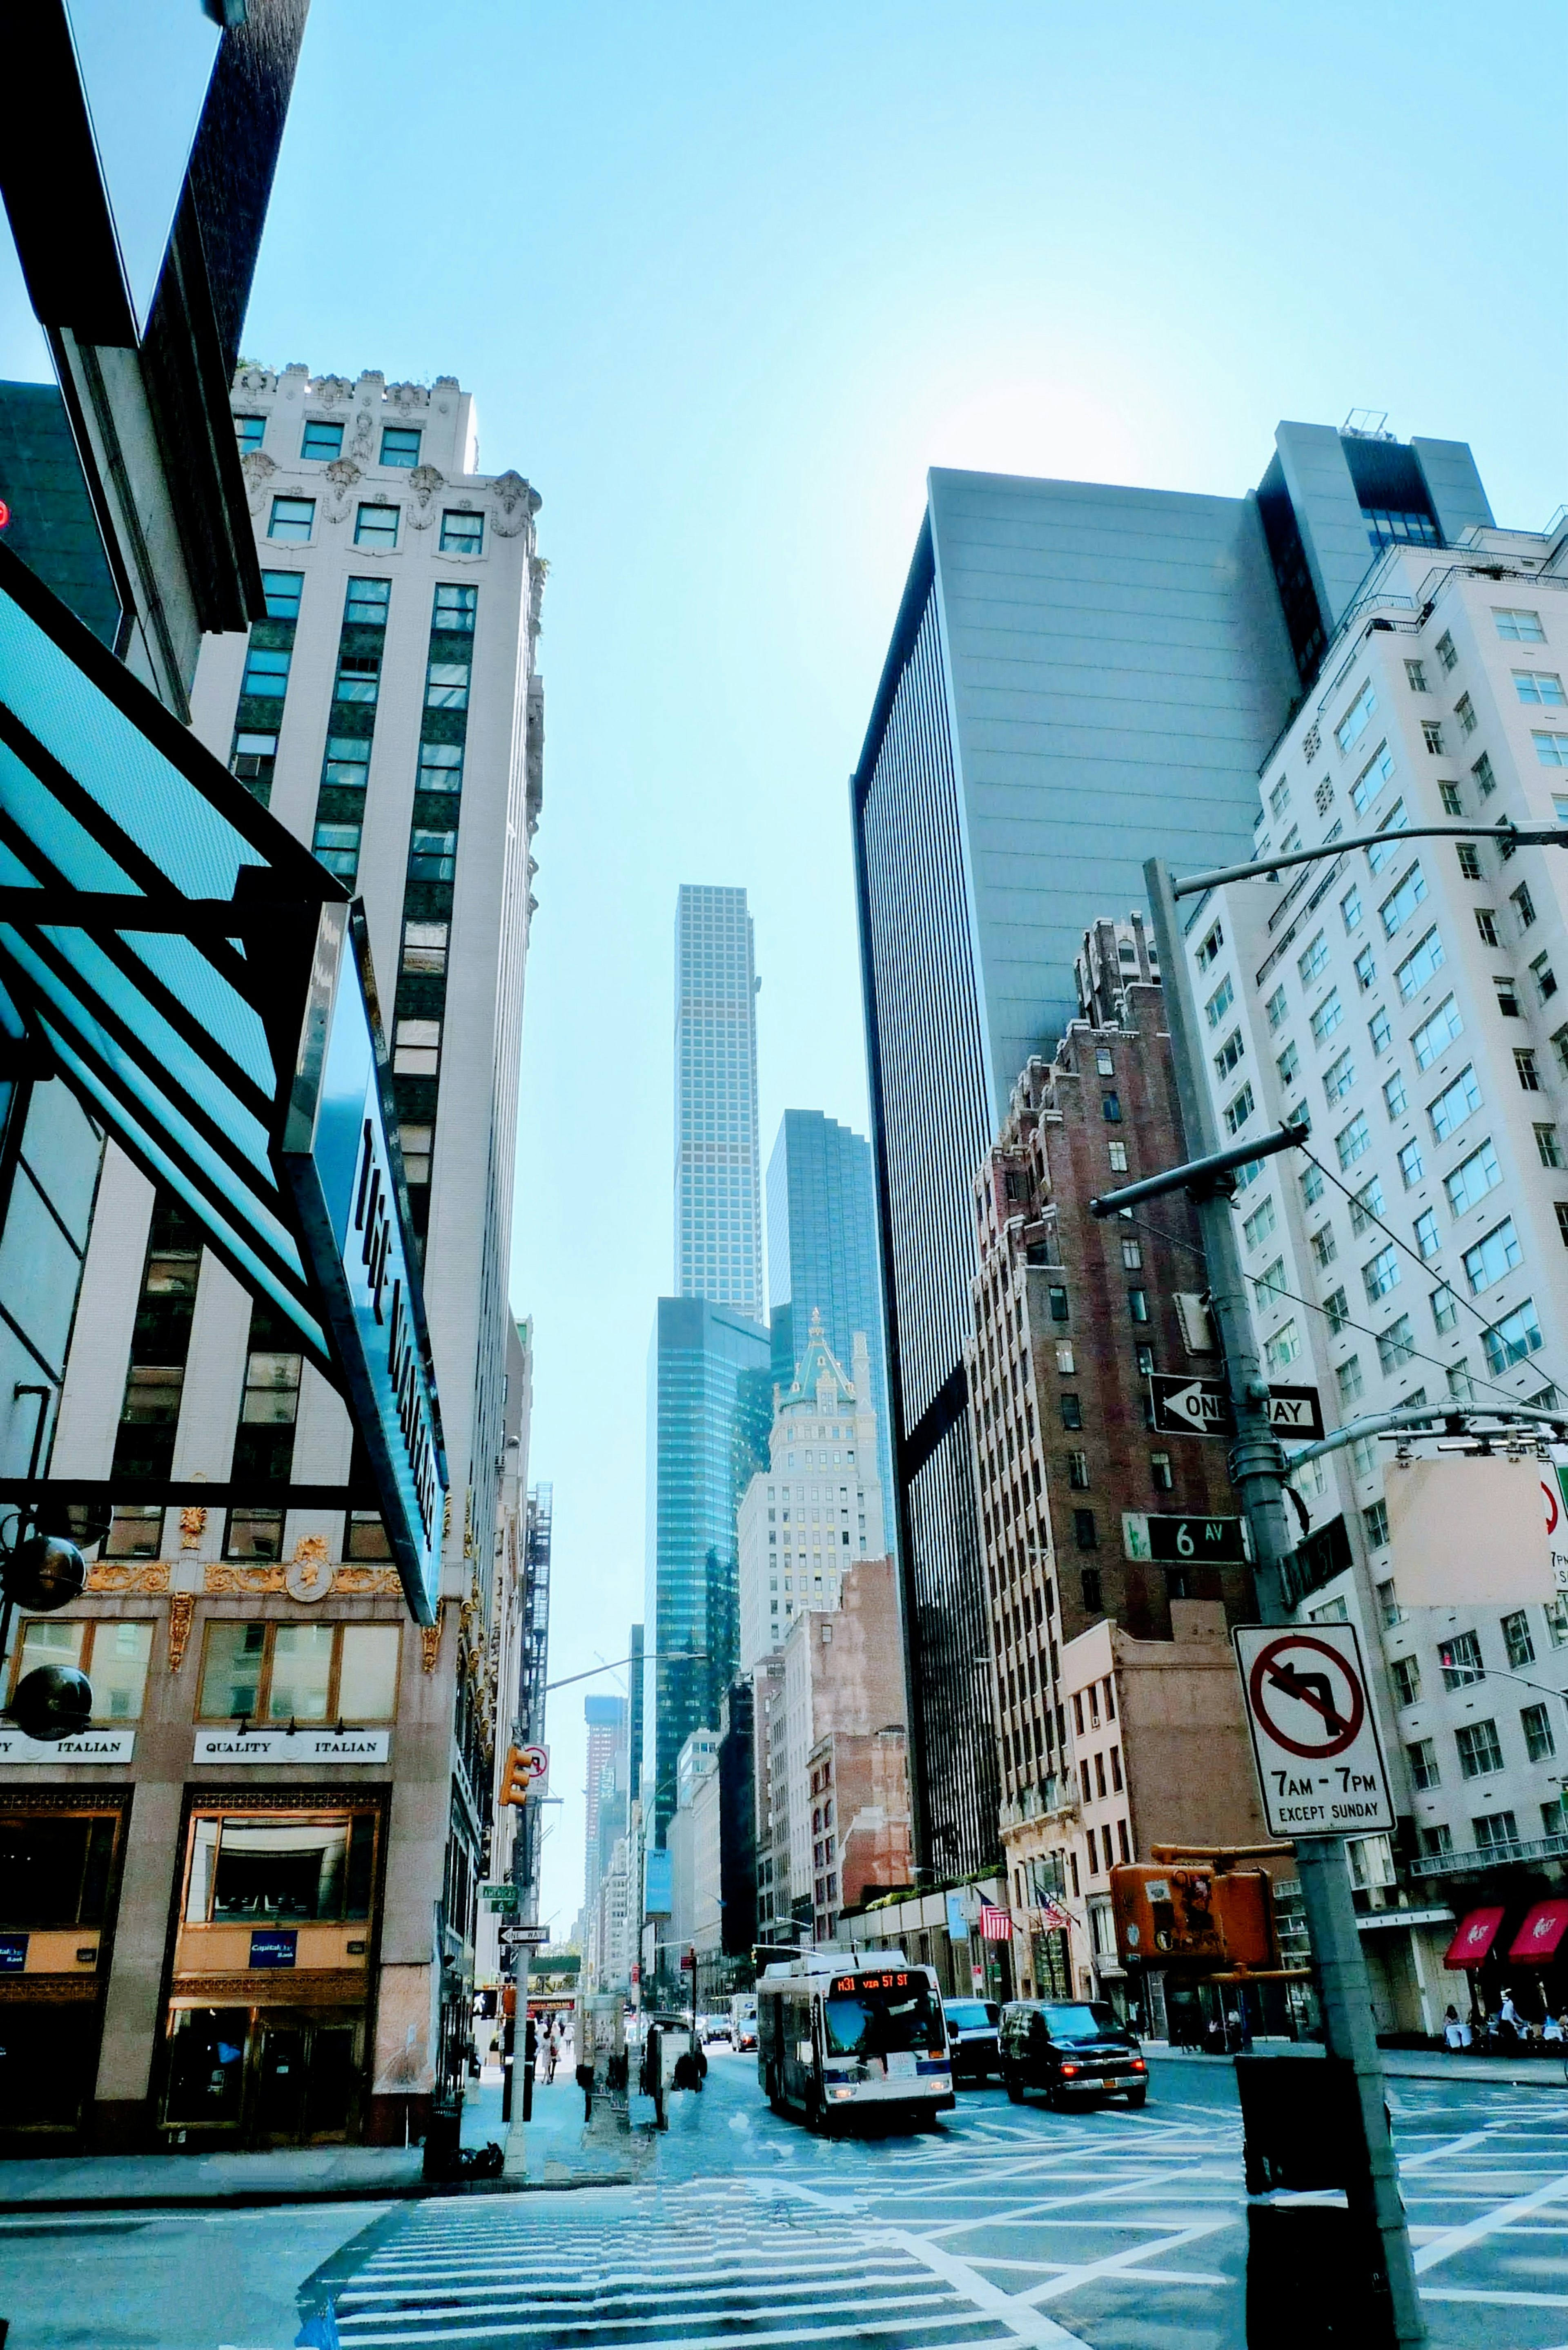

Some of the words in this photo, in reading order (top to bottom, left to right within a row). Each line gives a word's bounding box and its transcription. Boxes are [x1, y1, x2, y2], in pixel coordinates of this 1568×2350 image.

[1186, 1395, 1226, 1419] ONE
[1267, 1400, 1302, 1422] AY
[1176, 1523, 1194, 1556] 6
[1205, 1523, 1223, 1541] AV
[0, 1742, 12, 1752] Y
[57, 1742, 121, 1752] ITALIAN
[206, 1742, 272, 1752] QUALITY
[314, 1742, 377, 1752] ITALIAN
[1271, 1770, 1313, 1797] 7AM
[1334, 1767, 1376, 1793] 7PM
[1279, 1806, 1325, 1822] EXCEPT
[1332, 1802, 1378, 1818] SUNDAY
[483, 1890, 516, 1898] AMERICAS
[498, 1902, 504, 1911] 6
[862, 1980, 879, 1989] VIA
[882, 1975, 893, 1987] 57
[897, 1974, 908, 1986] ST
